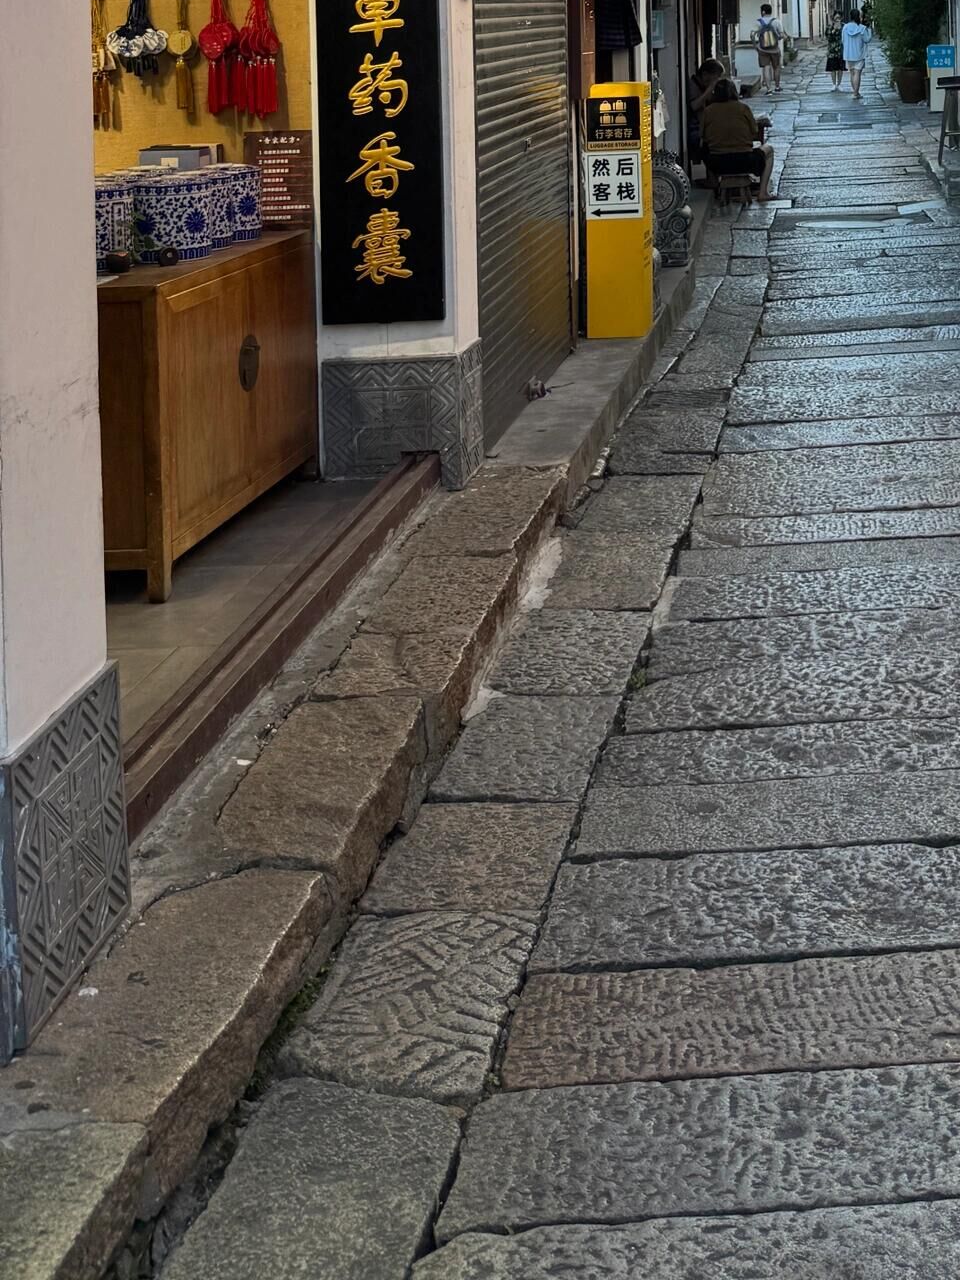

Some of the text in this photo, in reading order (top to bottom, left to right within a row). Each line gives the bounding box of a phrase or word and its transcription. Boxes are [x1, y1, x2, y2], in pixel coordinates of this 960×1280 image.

[595, 128, 632, 140] 行李寄存
[592, 157, 634, 177] 然后
[592, 182, 636, 201] 客栈
